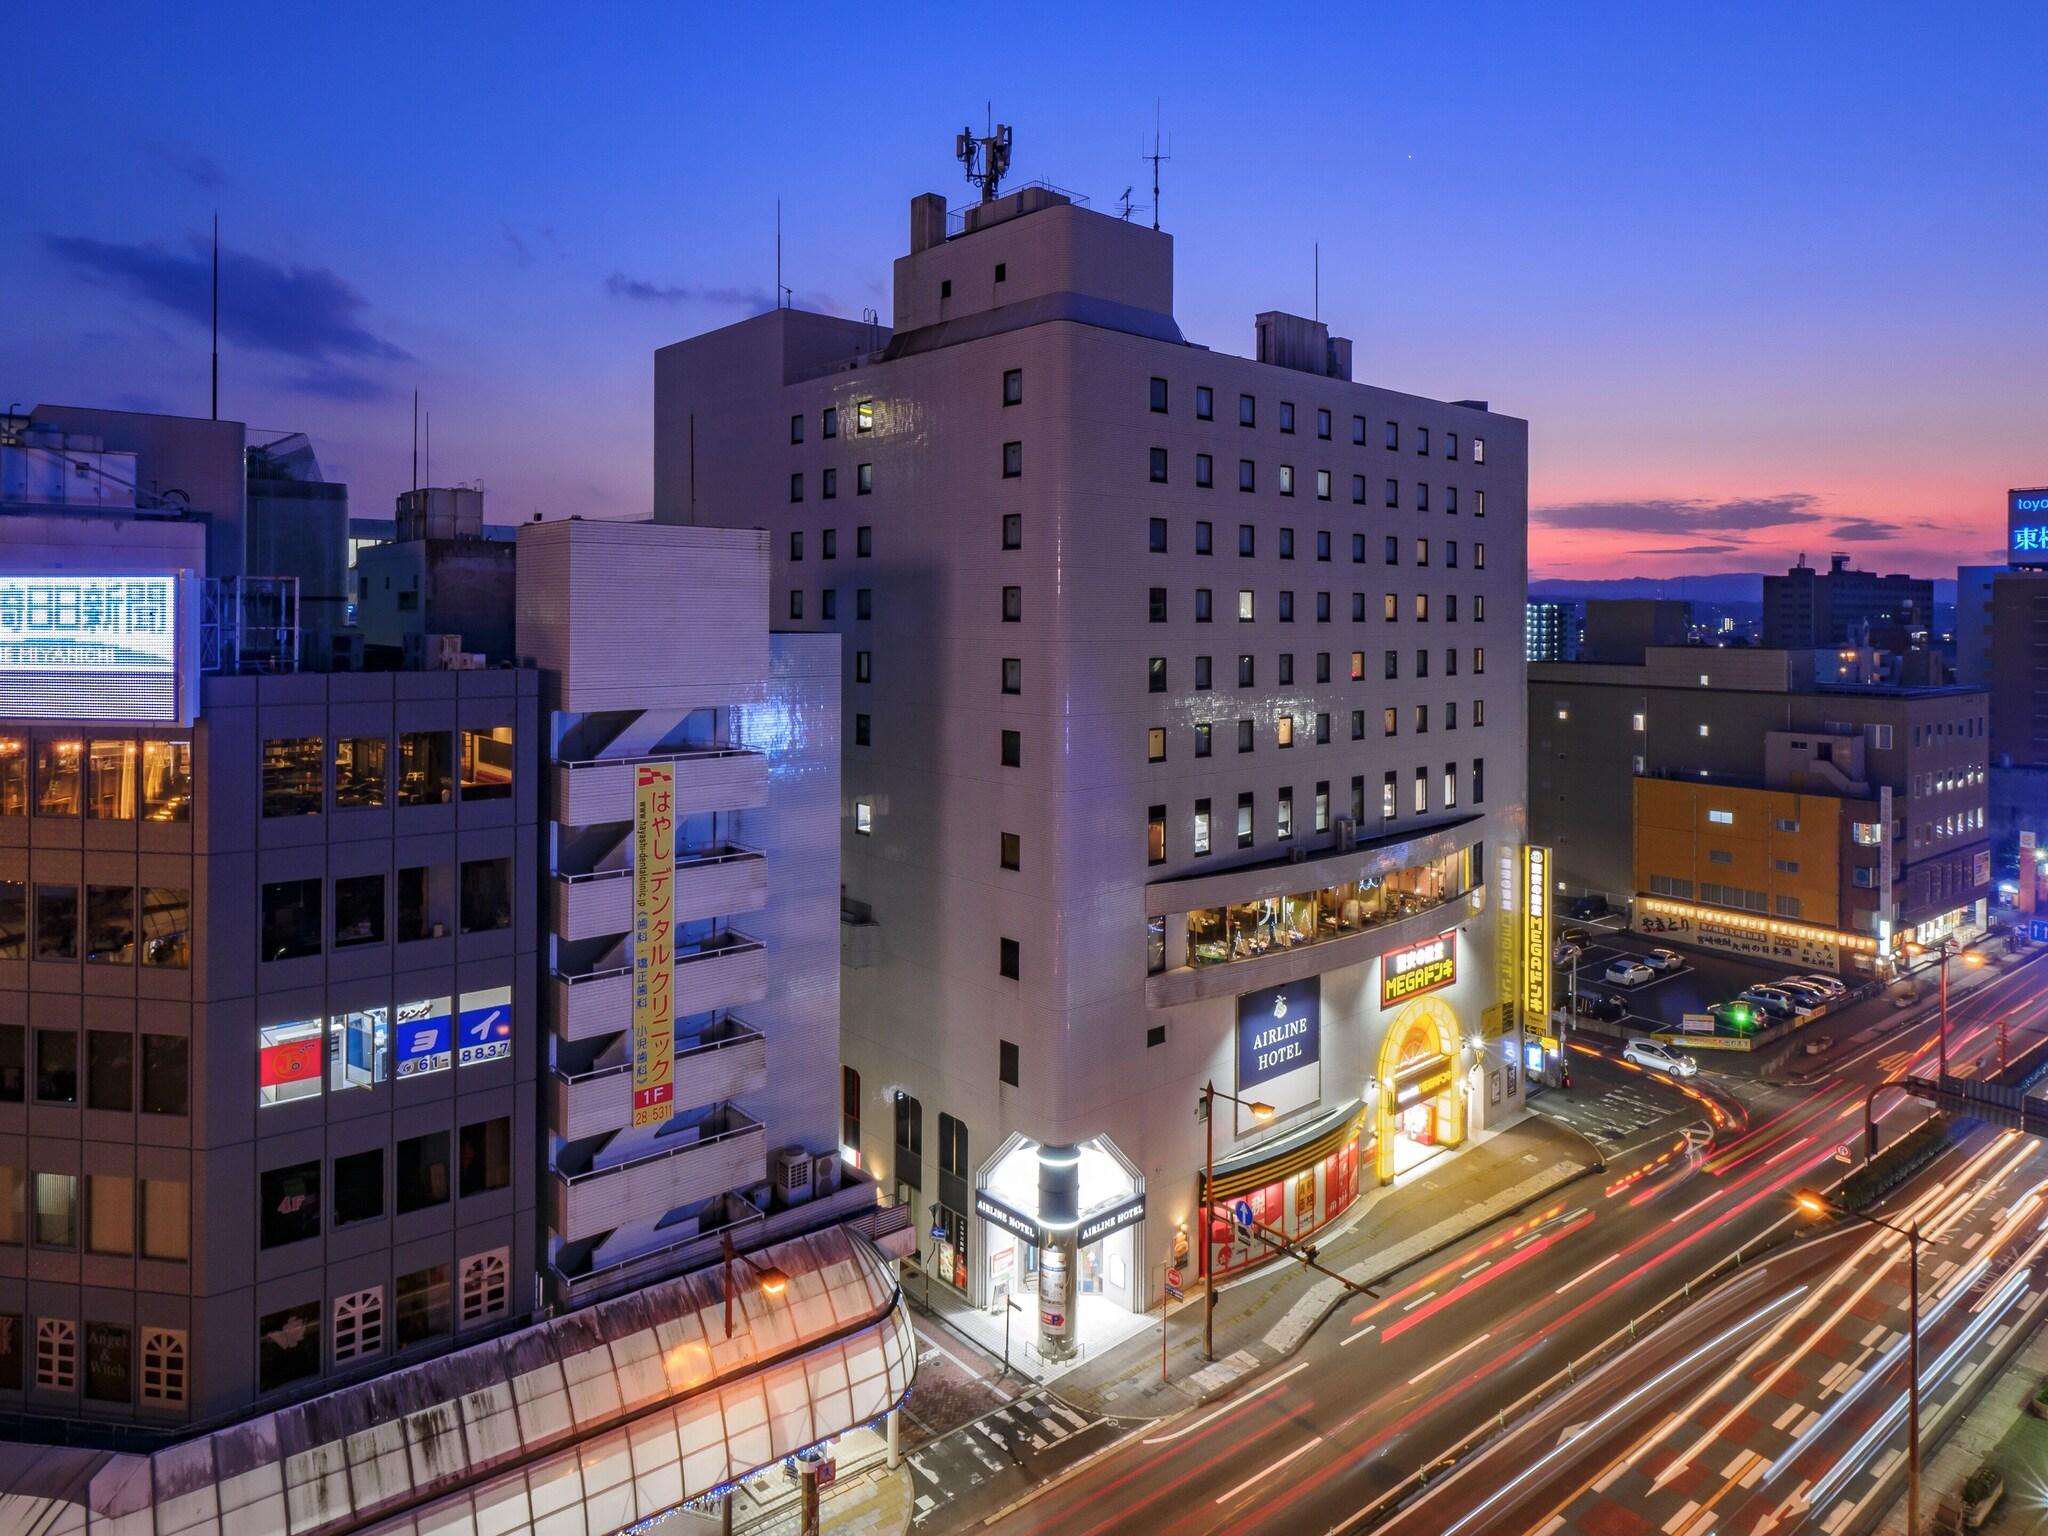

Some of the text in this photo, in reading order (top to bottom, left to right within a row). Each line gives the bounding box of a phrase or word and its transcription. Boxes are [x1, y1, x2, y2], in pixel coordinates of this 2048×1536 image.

[18, 647, 115, 663] MIYANICHI
[1642, 916, 1689, 932] やきとり
[1386, 959, 1453, 999] MEGAドンキ
[1253, 1018, 1308, 1050] AIRLINE
[1258, 1042, 1302, 1071] HOTEL
[644, 1086, 665, 1105] 1F
[977, 1201, 1035, 1238] AIRLINE HOTEL
[1082, 1204, 1144, 1240] AIRLINE HOTEL
[88, 1332, 127, 1348] Angel
[90, 1361, 126, 1377] Witch
